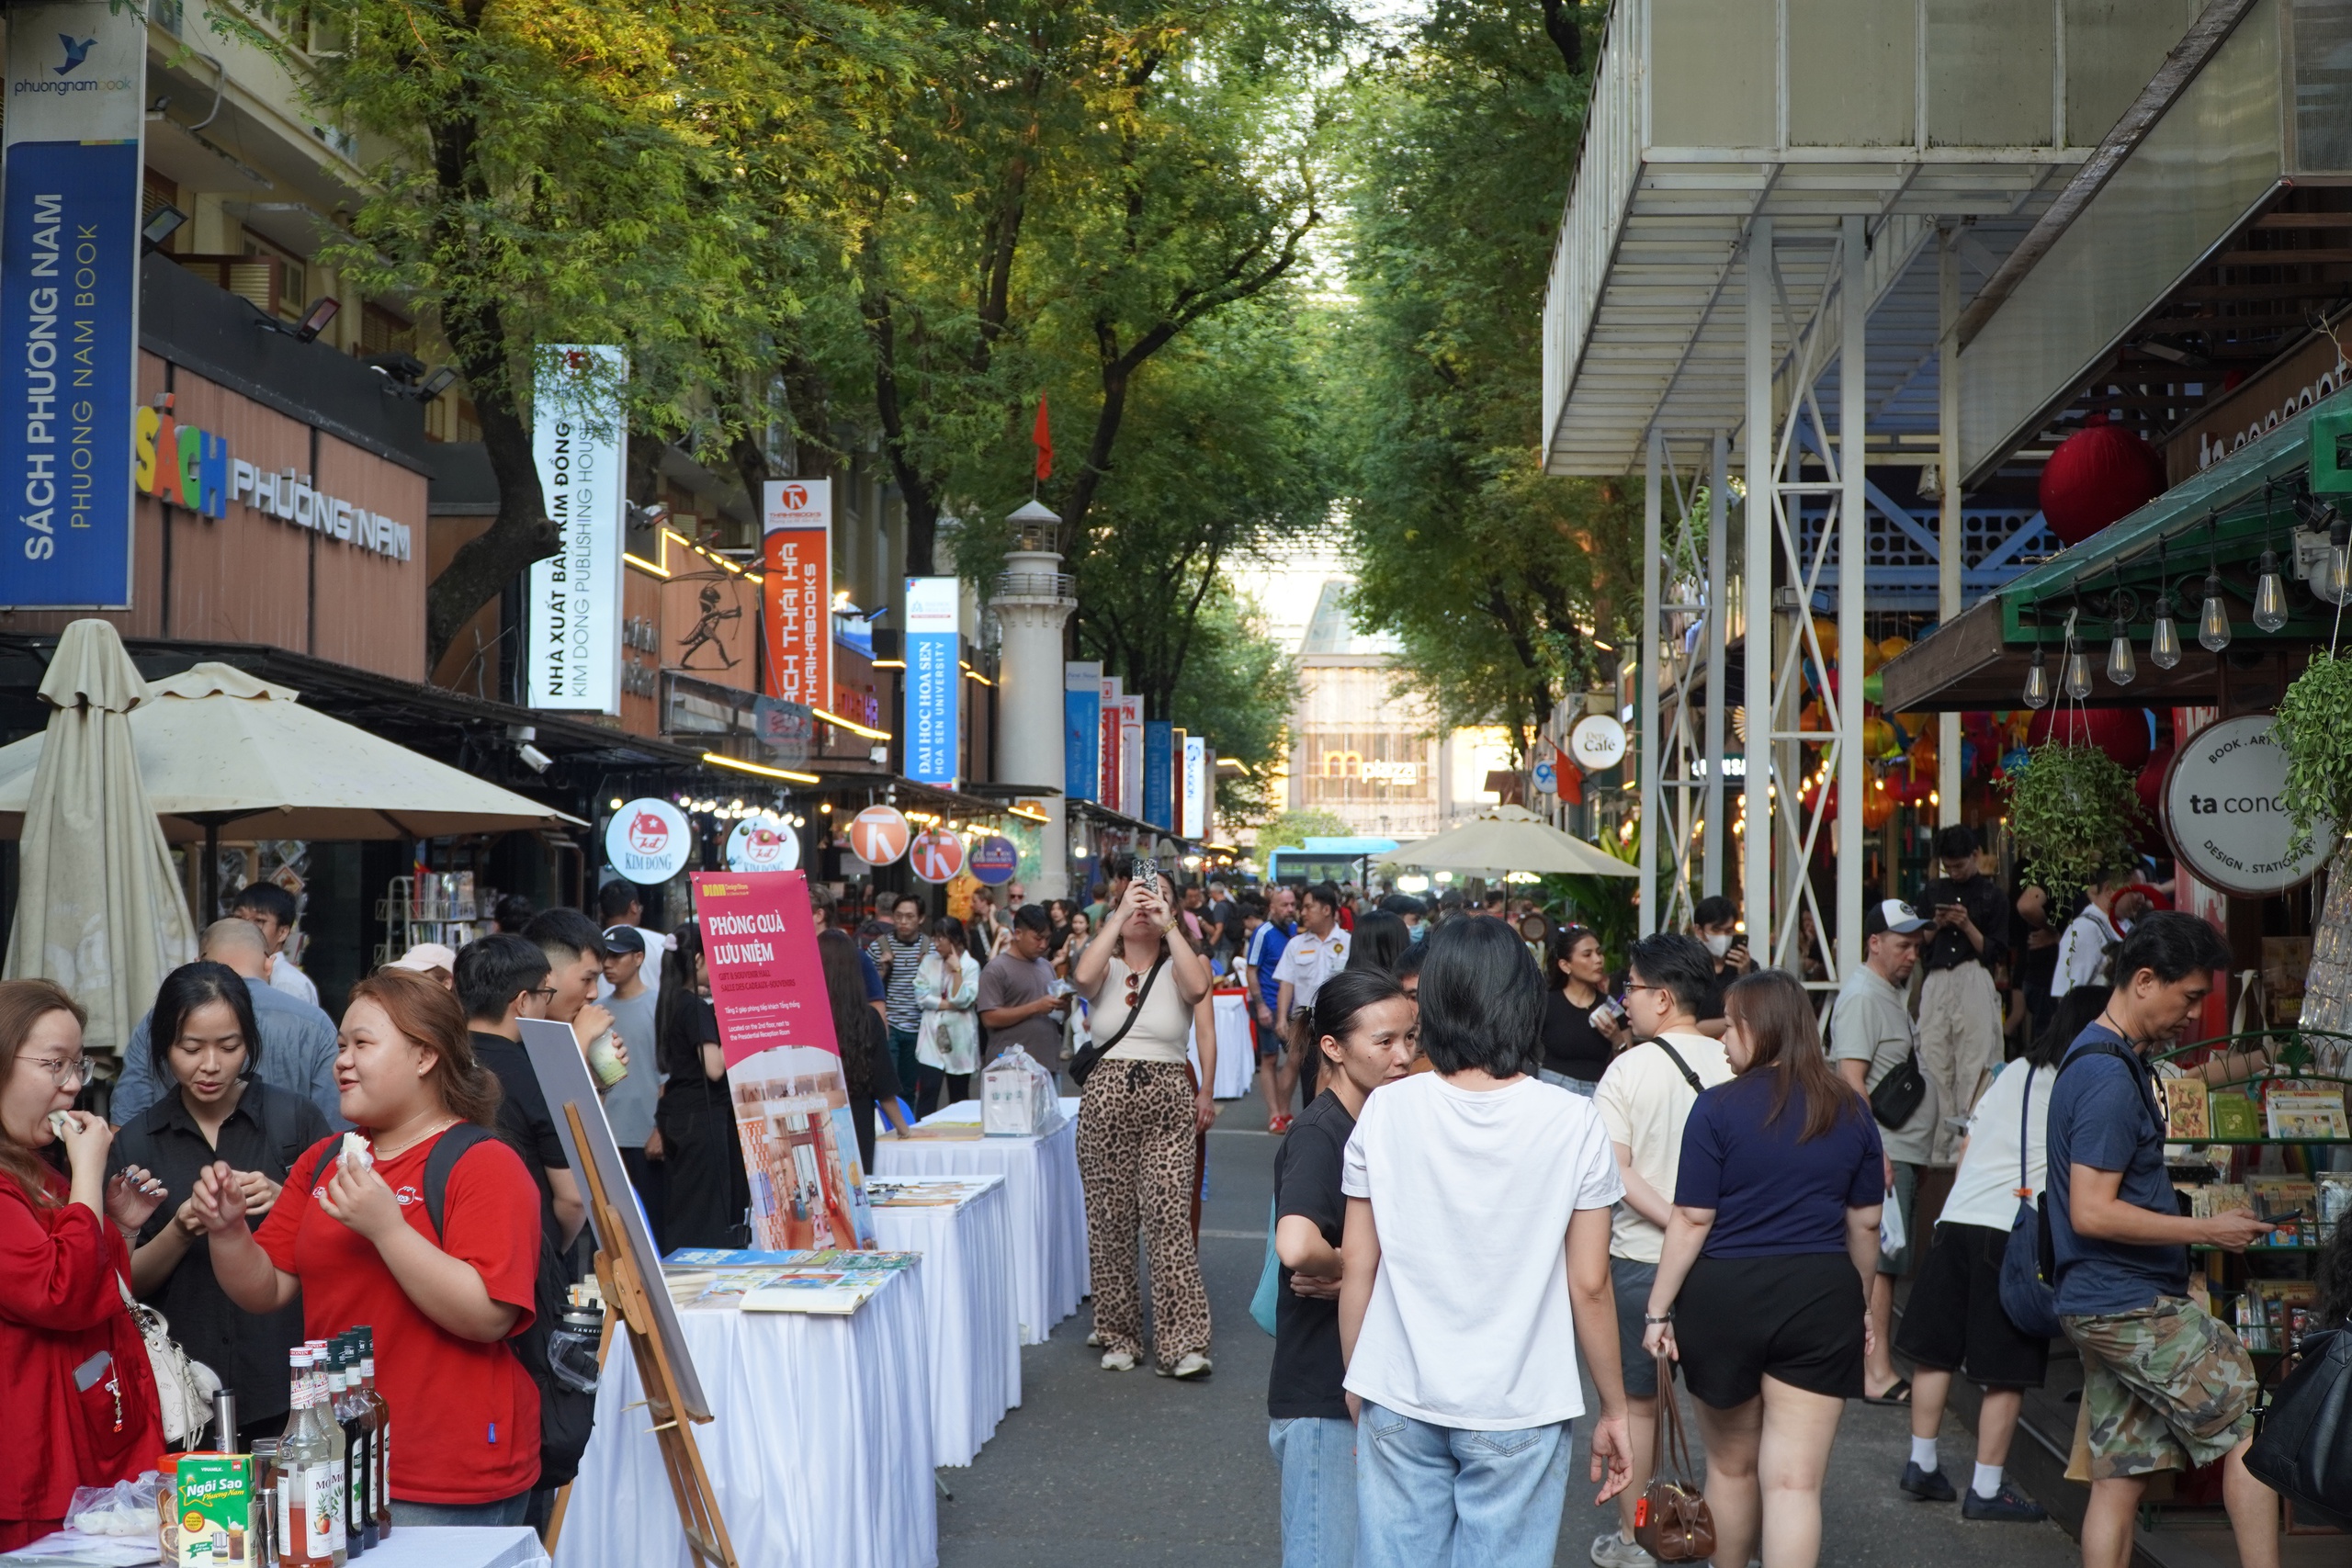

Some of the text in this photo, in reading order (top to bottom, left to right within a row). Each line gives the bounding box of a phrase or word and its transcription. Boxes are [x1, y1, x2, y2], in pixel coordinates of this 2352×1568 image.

[15, 76, 131, 96] phuongnambook
[19, 194, 62, 560] SÁCH PHƯƠNG NAM
[71, 224, 97, 528] PHUONG NAM BOOK
[135, 392, 227, 520] SÁCH
[548, 422, 571, 487] ĐỒNG
[553, 493, 569, 533] KIM
[357, 509, 411, 561] NAM
[574, 489, 594, 592] PUBLISHING
[778, 543, 799, 581] HÀ
[545, 590, 566, 644] XUẤT
[573, 598, 591, 660] DONG
[779, 588, 799, 648] THÁI
[804, 563, 818, 705] THAIHABOOKS
[545, 649, 565, 696] NHÀ
[919, 641, 932, 671] SEN
[571, 665, 588, 697] KIM
[919, 672, 932, 706] HOA
[935, 641, 944, 774] HOA SEN UNIVERSITY
[2208, 739, 2242, 764] BOOK
[2189, 795, 2218, 815] ta
[625, 852, 643, 870] KIM
[2203, 840, 2244, 871] DESIGN
[708, 909, 786, 935] PHÒNG QUÀ
[714, 938, 775, 966] LƯU NIỆM
[728, 1024, 745, 1032] Located
[738, 1032, 761, 1040] Presidential
[759, 1030, 779, 1038] Reception
[187, 1479, 243, 1497] Ngôi Sao
